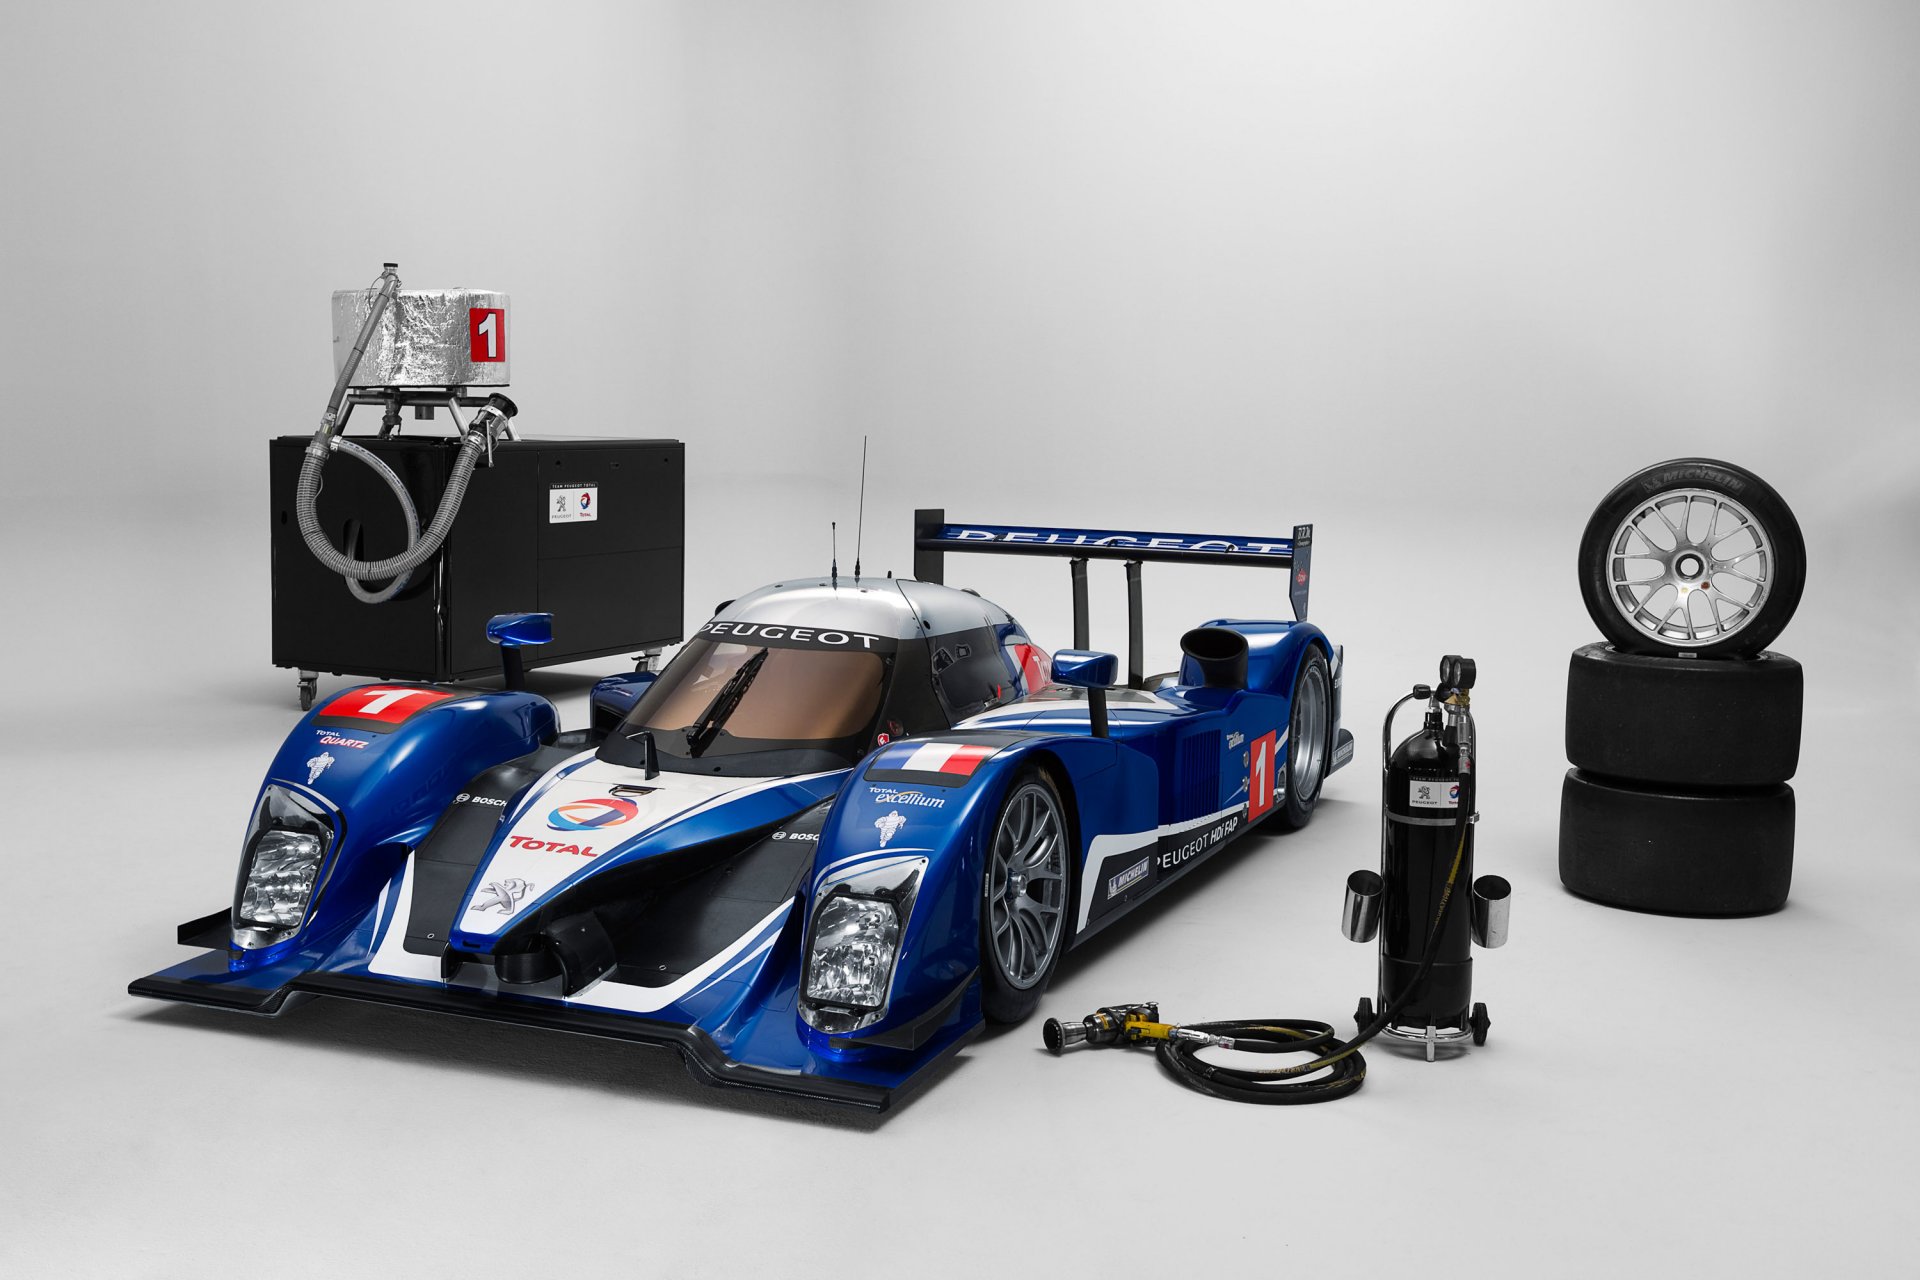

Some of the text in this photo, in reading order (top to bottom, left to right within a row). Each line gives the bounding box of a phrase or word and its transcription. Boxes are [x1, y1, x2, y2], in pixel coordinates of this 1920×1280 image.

[478, 312, 497, 358] 1
[357, 689, 424, 715] 1
[316, 729, 341, 737] TOTAL
[320, 736, 369, 749] QUARTZ
[1255, 740, 1267, 808] 1
[875, 793, 945, 808] excellium
[789, 833, 819, 841] BOSC
[1224, 816, 1238, 837] FAP
[509, 835, 599, 858] TOTAL
